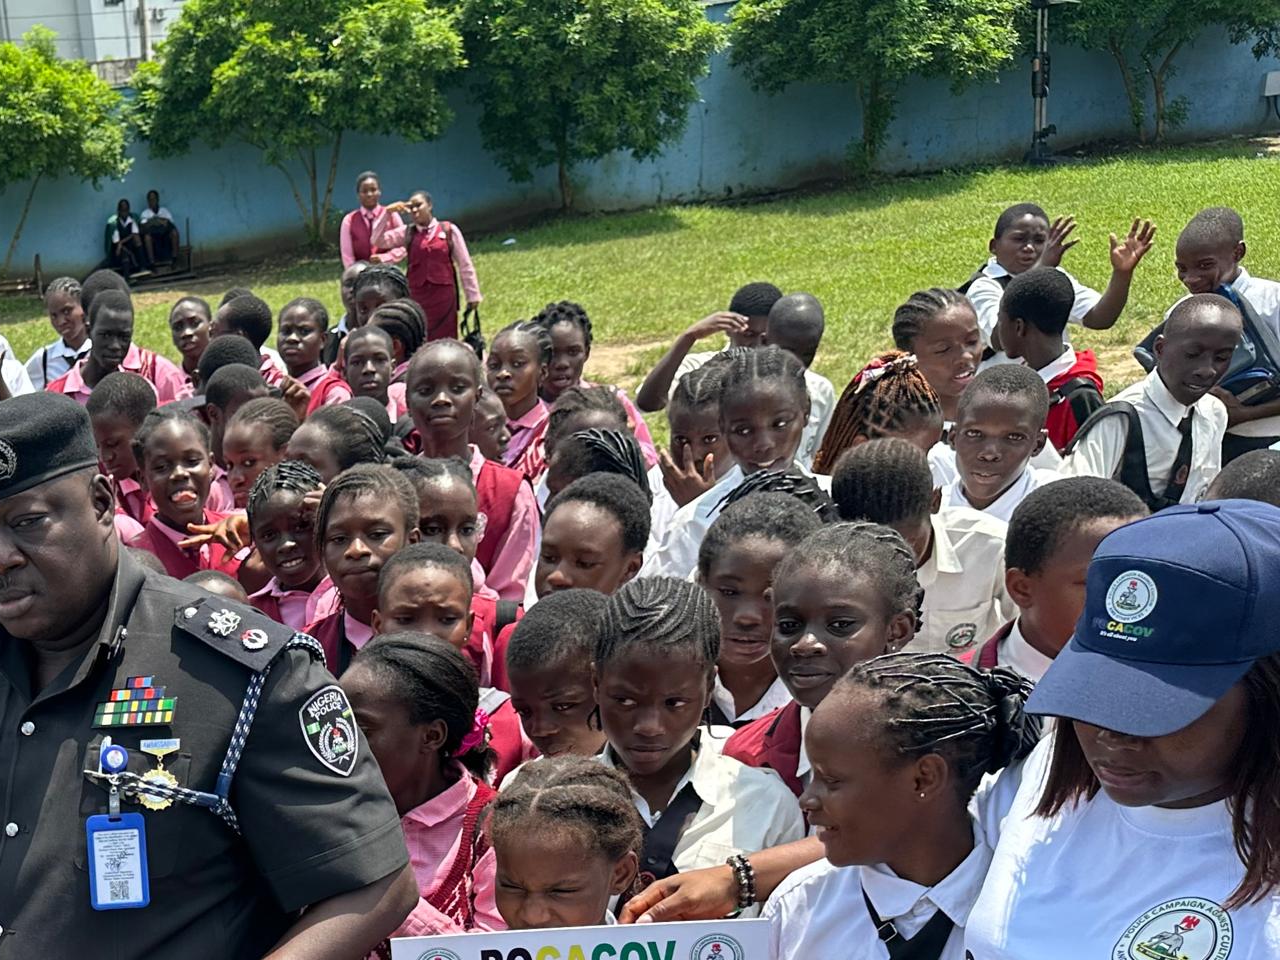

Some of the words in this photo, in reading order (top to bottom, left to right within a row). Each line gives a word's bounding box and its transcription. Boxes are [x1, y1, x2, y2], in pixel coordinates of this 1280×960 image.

[307, 691, 343, 718] NIGERIA
[315, 701, 342, 721] POLICE
[1124, 915, 1152, 940] POLICE
[1151, 900, 1206, 916] CAMPAIGN
[1206, 905, 1229, 932] AGAINST
